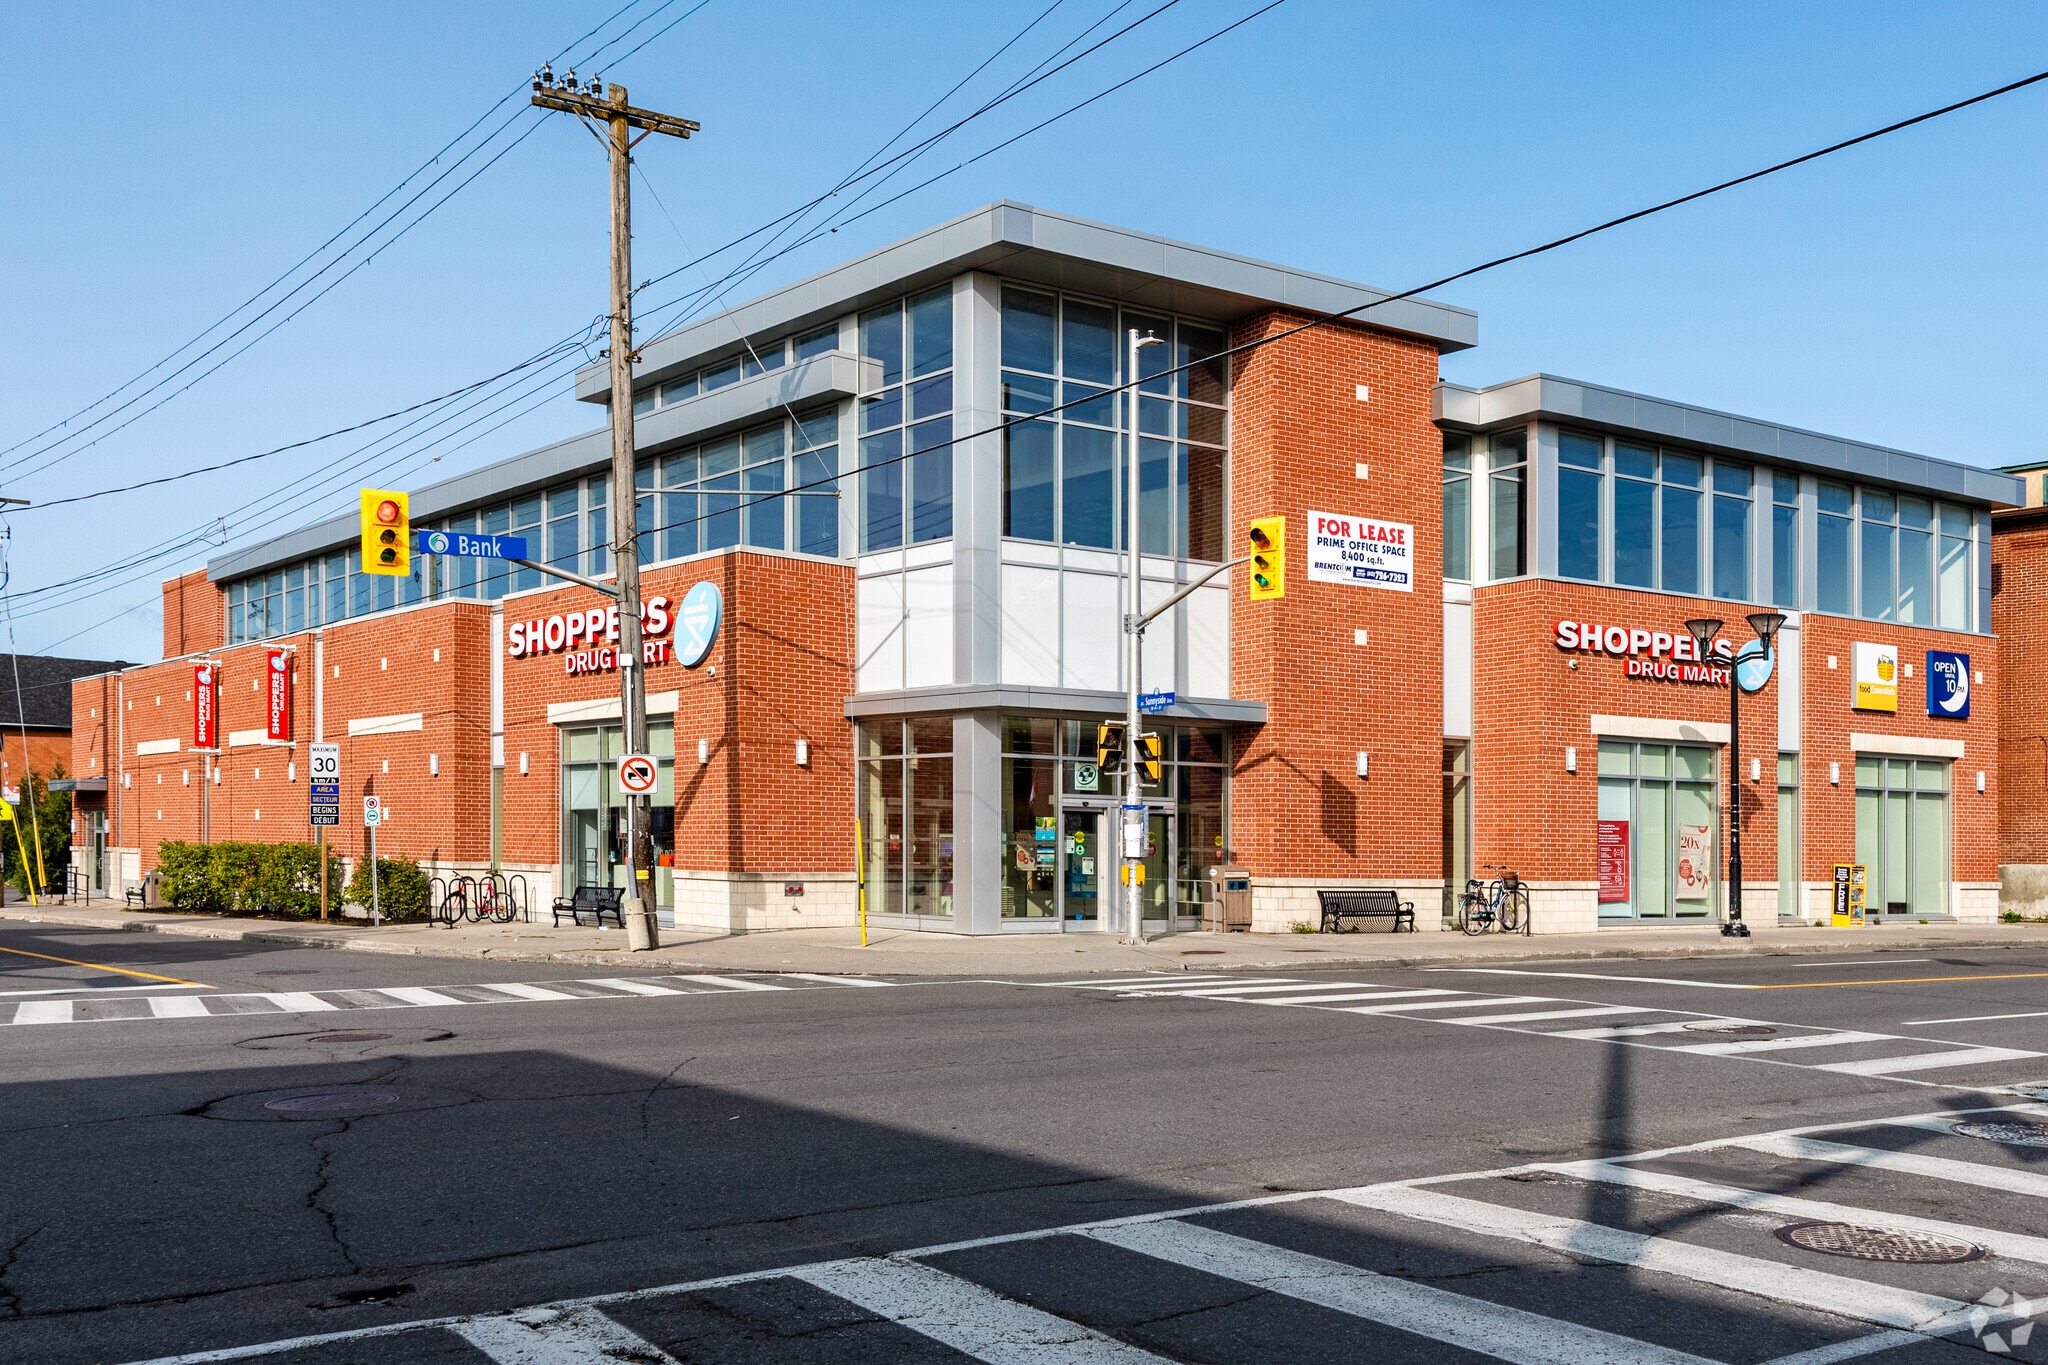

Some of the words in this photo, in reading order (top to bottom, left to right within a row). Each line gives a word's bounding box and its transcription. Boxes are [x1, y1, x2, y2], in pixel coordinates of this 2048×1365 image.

[1317, 517, 1351, 538] FOR
[1358, 523, 1405, 545] LEASE
[458, 535, 502, 558] Bank
[1317, 536, 1345, 549] PRIME
[1348, 540, 1379, 553] OFFICE
[1381, 544, 1406, 557] SPACE
[1341, 550, 1365, 562] 8,400
[565, 648, 611, 673] DRUG
[1934, 661, 1956, 674] OPEN
[1628, 660, 1679, 680] DRUG
[1683, 666, 1732, 684] MART
[1945, 679, 1956, 693] 10
[198, 685, 206, 742] SHOPPERS
[272, 672, 280, 735] SHOPPERS
[313, 757, 336, 773] 30
[312, 806, 337, 814] BEGINS
[1680, 835, 1700, 850] 20x
